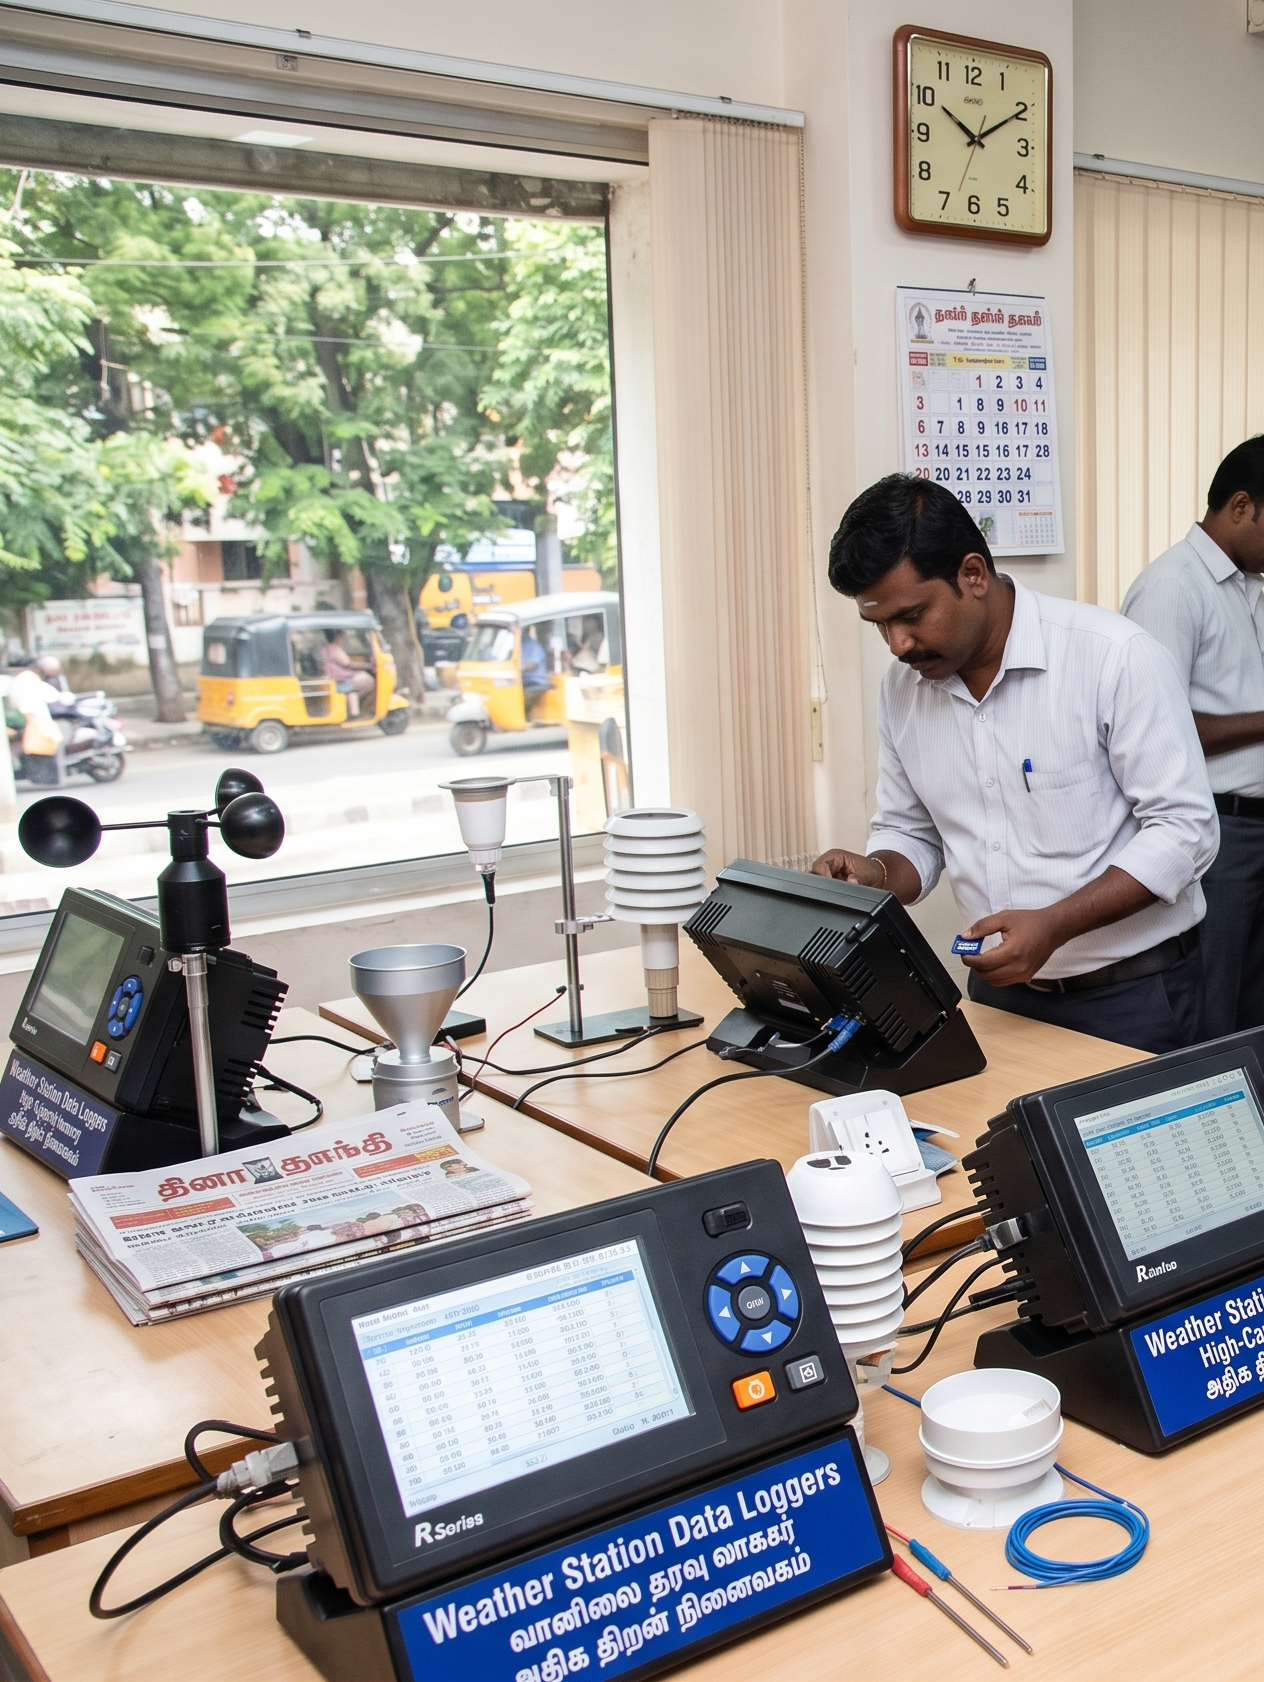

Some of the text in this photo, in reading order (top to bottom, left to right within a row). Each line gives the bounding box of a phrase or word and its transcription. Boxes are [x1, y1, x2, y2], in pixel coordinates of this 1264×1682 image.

[936, 60, 1005, 91] 11 12 1
[915, 84, 935, 107] 10
[916, 122, 930, 143] 9
[1016, 137, 1030, 158] 3
[918, 160, 932, 181] 8
[1015, 174, 1029, 195] 4
[938, 190, 1010, 217] 7 6 5
[975, 374, 1043, 390] 1 2 3 4
[916, 395, 1046, 413] 3 1 8 9 10 11
[917, 419, 1048, 436] 6 7 8 9 16 17 18
[914, 443, 1050, 459] 13 14 15 15 16 17 28
[935, 467, 950, 481] 20
[955, 467, 970, 481] 21
[976, 467, 991, 481] 22
[996, 467, 1011, 481] 23
[1016, 467, 1032, 481] 24
[977, 490, 992, 504] 29
[996, 489, 1013, 505] 30
[1017, 489, 1031, 504] 31
[1143, 1310, 1223, 1358] Weather
[1206, 1365, 1253, 1400] அதிக
[415, 1522, 434, 1548] R
[422, 1462, 841, 1644] Weather Station Data Loggers
[510, 1581, 642, 1653] வானிலை
[649, 1554, 710, 1603] தரவு
[597, 1606, 670, 1668] திறன்
[675, 1545, 811, 1633] நினைவகம்
